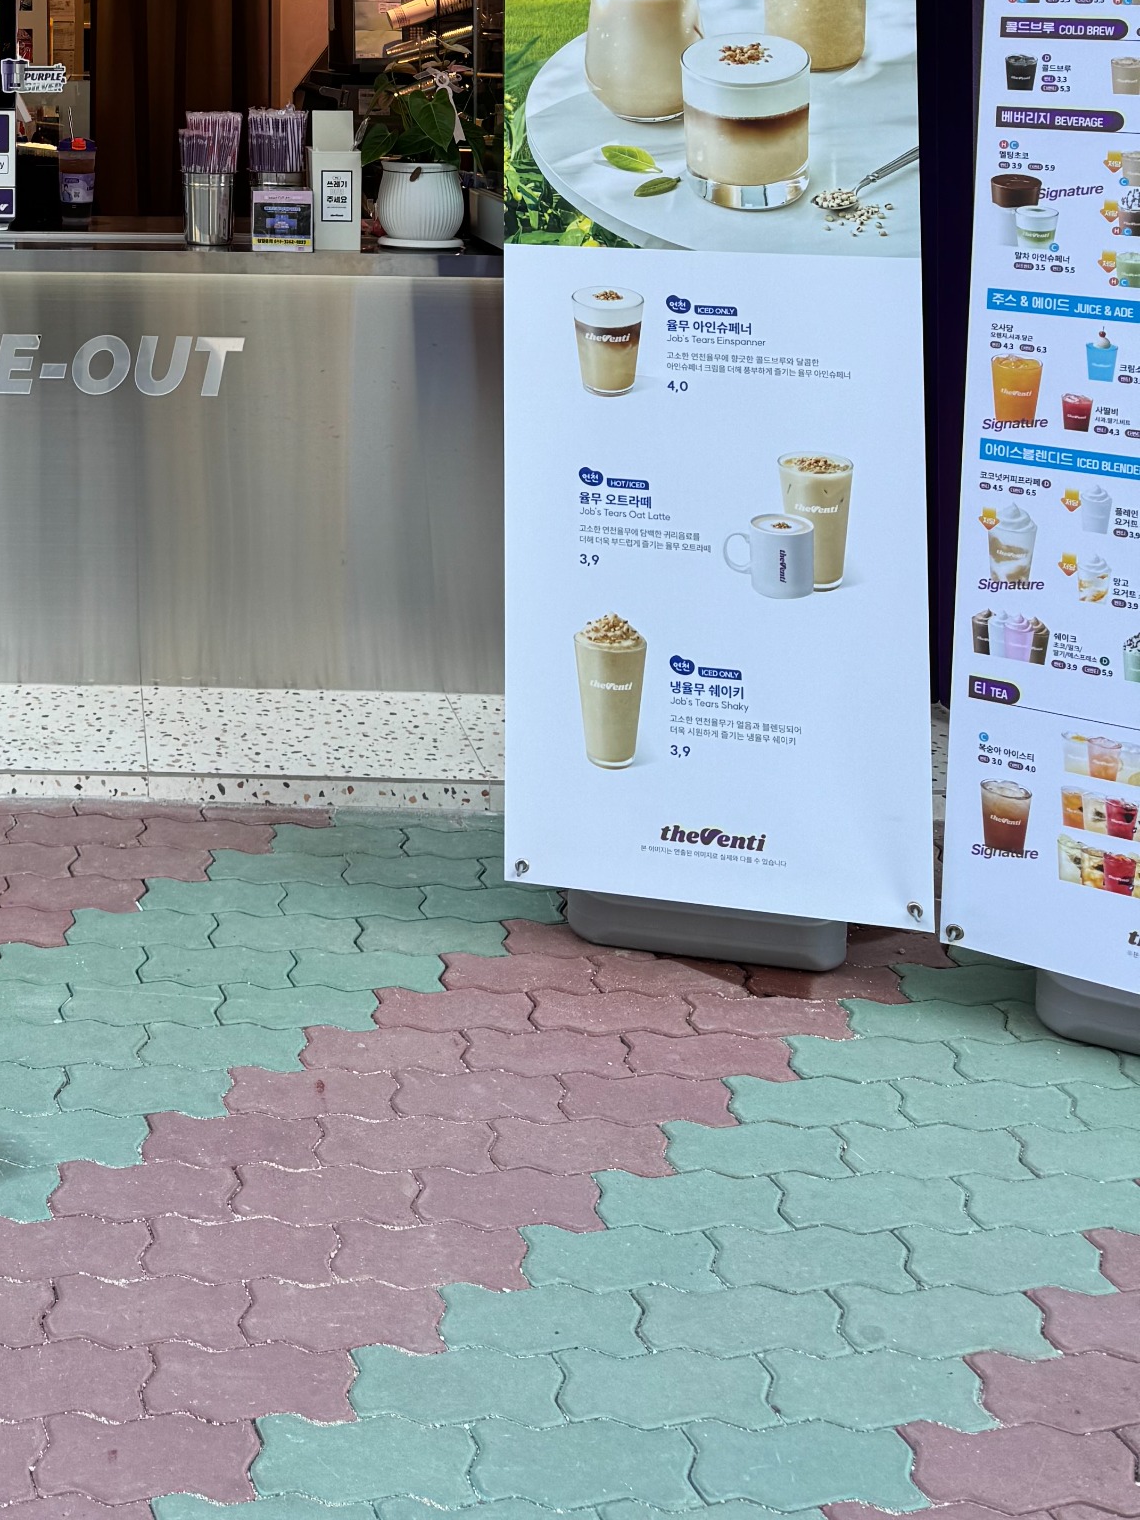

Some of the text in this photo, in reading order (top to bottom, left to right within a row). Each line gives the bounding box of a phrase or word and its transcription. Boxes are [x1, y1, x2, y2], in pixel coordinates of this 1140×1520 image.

[1005, 20, 1115, 36] 콜드브루 COLD BREW
[24, 72, 62, 81] PURPLE
[1001, 110, 1104, 128] 베버리지 BEVERAGE
[1039, 184, 1104, 201] Signature
[1031, 252, 1071, 264] 아인슈페너
[697, 307, 736, 316] ICED ONLY
[991, 292, 1134, 318] 주스 & 에이드 JUICE & ADE
[666, 319, 752, 336] 율무 아인슈페너
[666, 334, 766, 347] Job's Tears Einspanner
[666, 351, 690, 361] 고소한
[666, 362, 703, 372] 아인슈페너
[727, 365, 742, 375] 더해
[774, 368, 796, 378] 즐기는
[814, 369, 851, 380] 아인슈페너
[666, 380, 689, 393] 4,0
[981, 417, 1049, 433] Signature
[984, 443, 1074, 466] 아이스블렌디드
[1076, 456, 1100, 470] ICED
[610, 480, 646, 489] HOT/ICED
[579, 491, 652, 509] 율무 오트라떼
[579, 506, 671, 521] Job's Tears Oat Latte
[1114, 507, 1139, 519] 플레인
[579, 524, 601, 534] 고소한
[640, 528, 662, 539] 담백한
[579, 535, 594, 544] 더해
[595, 536, 610, 545] 더욱
[641, 539, 664, 550] 즐기는
[579, 553, 600, 566] 3,9
[977, 578, 1045, 593] Signature
[1053, 632, 1077, 643] 쉐이크
[701, 668, 740, 679] ICED ONLY
[669, 680, 744, 700] 냉율무 쉐이키
[990, 686, 1008, 700] TEA
[669, 696, 750, 713] Job's Tears Shaky
[669, 714, 693, 725] 고소한
[669, 726, 686, 735] 더욱
[687, 727, 719, 739] 시원하게
[720, 730, 745, 741] 즐기는
[669, 744, 691, 758] 3,9
[978, 743, 1035, 763] 복숭아 아이스티
[660, 824, 767, 852] theVenti
[971, 842, 1039, 860] Signature
